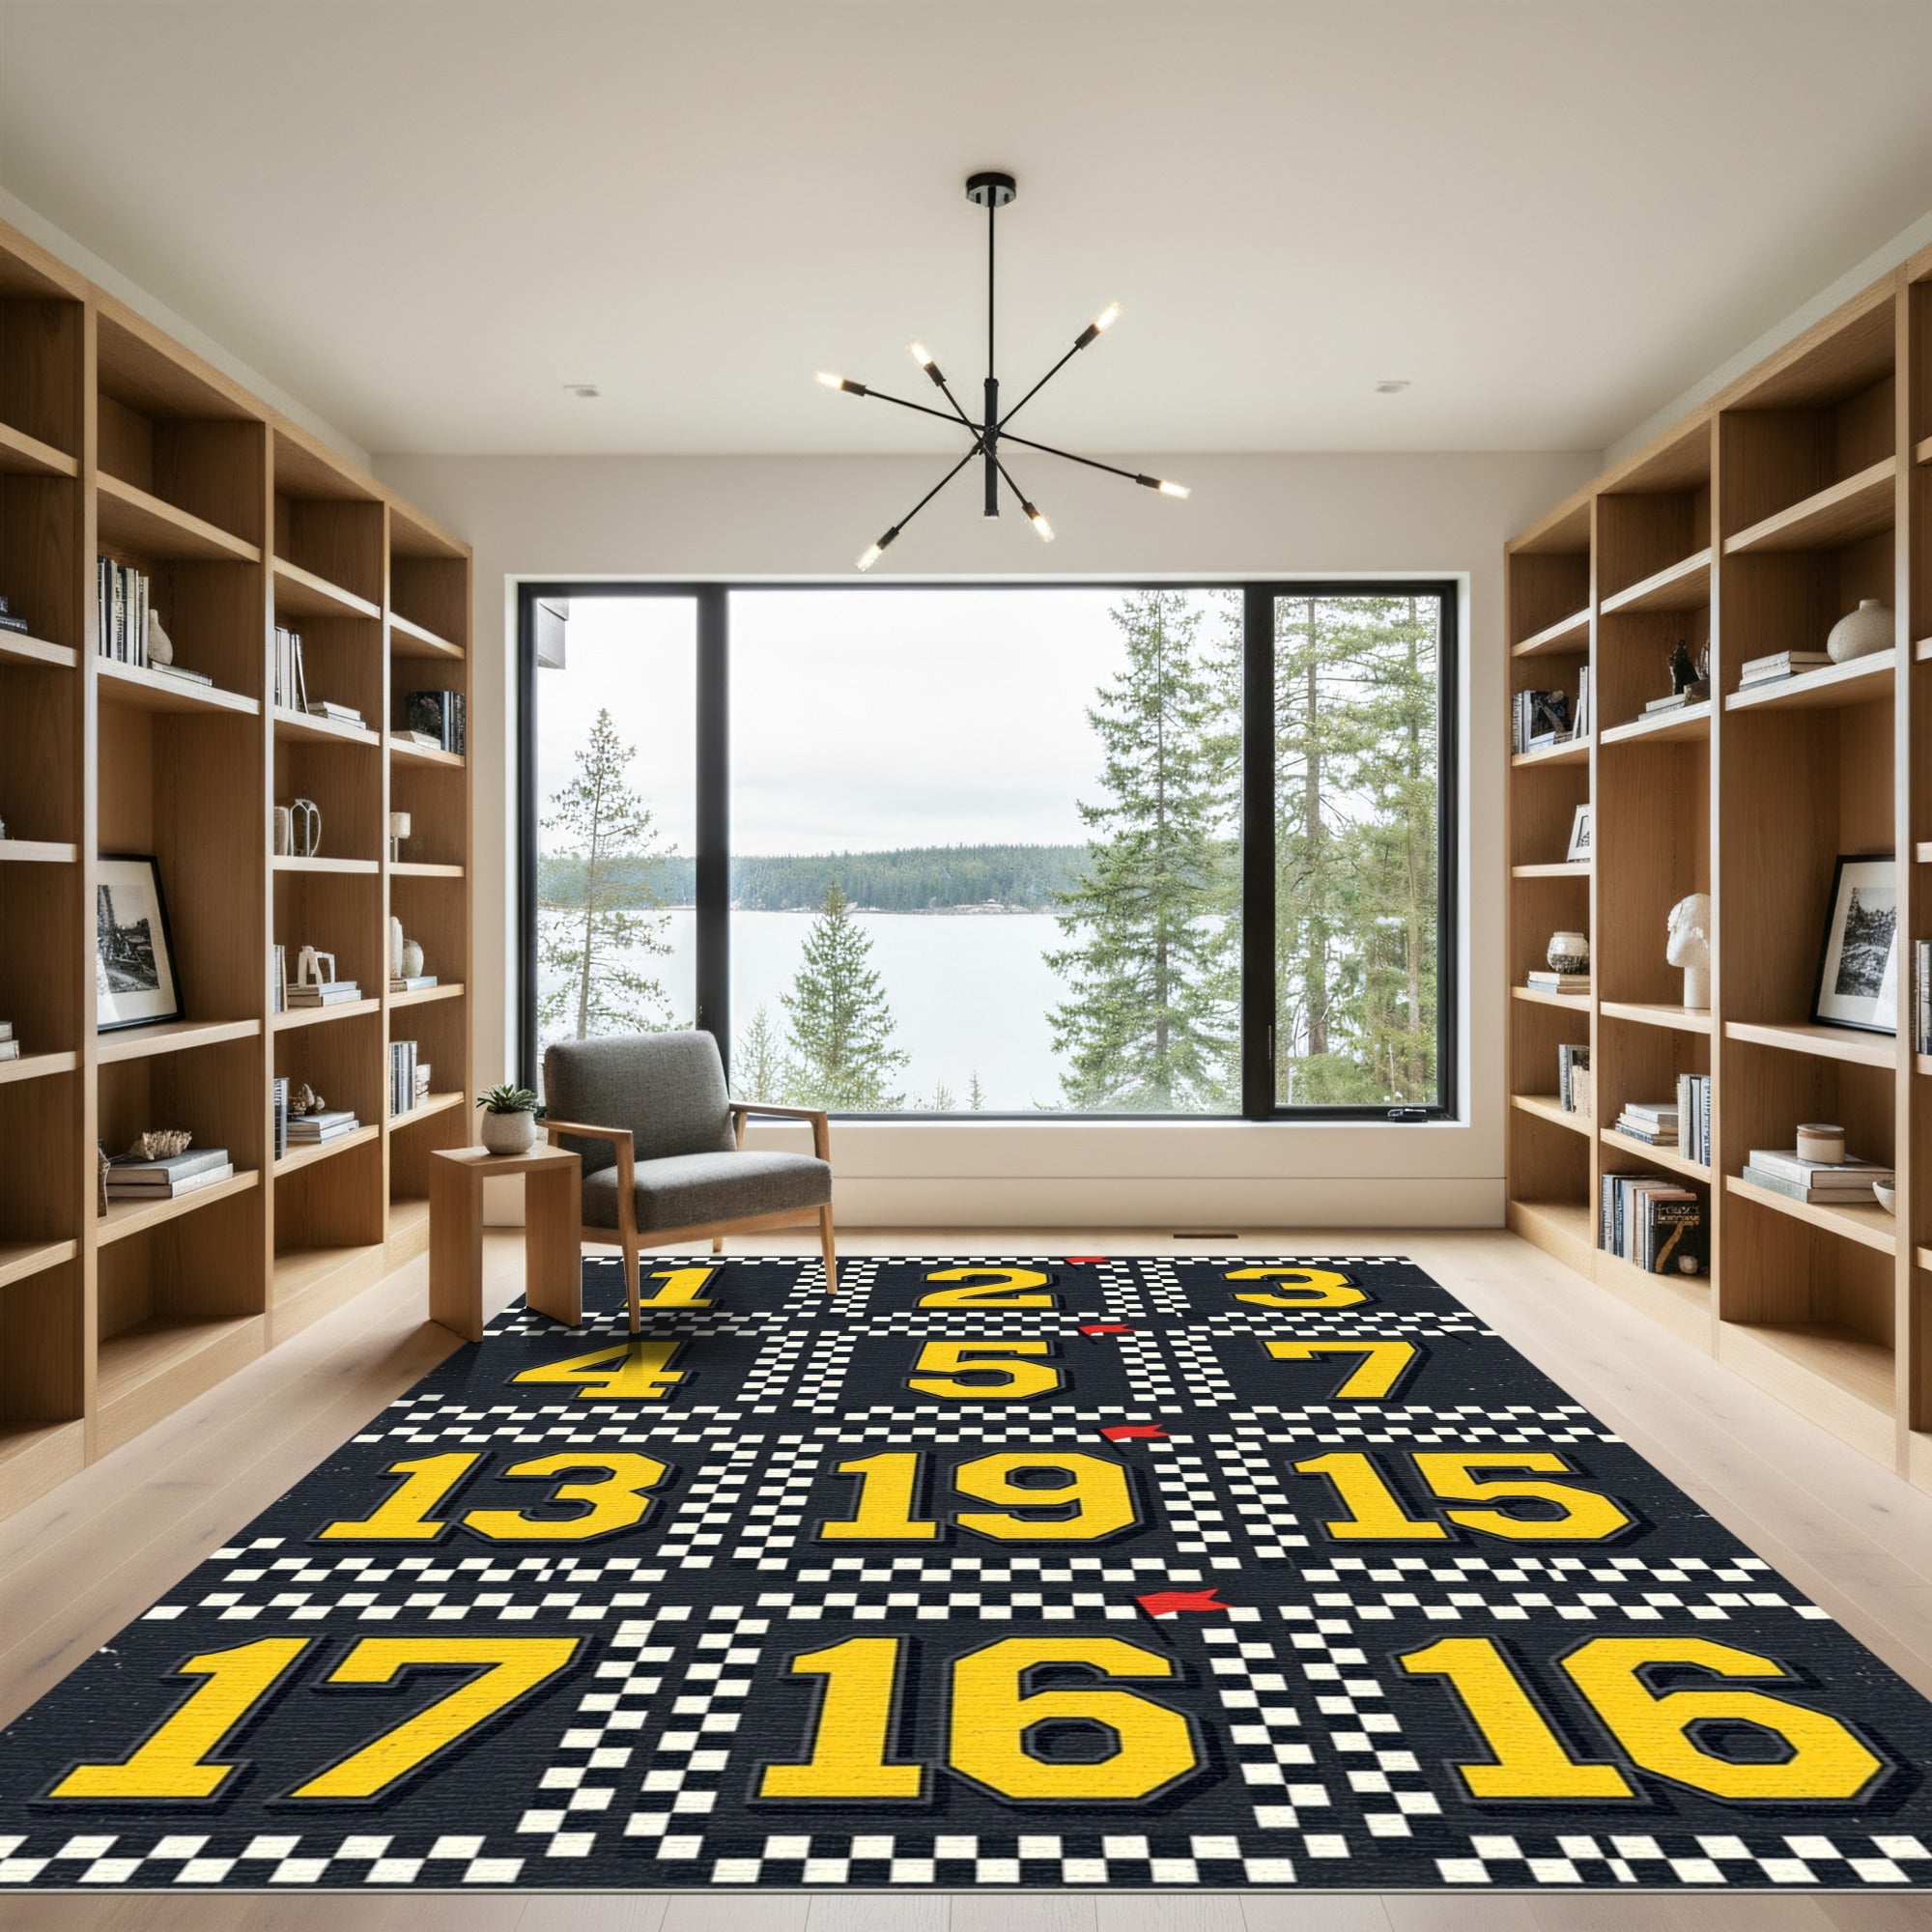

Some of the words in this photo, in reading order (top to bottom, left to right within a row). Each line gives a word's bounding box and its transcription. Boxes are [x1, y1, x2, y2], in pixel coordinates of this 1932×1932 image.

[621, 1267, 715, 1308] 1
[917, 1267, 1054, 1308] 2
[1224, 1267, 1366, 1308] 3
[511, 1340, 685, 1399] 4
[907, 1341, 1060, 1399] 5
[1264, 1341, 1414, 1399] 7
[318, 1451, 666, 1541] 13
[820, 1451, 1136, 1541] 19
[1293, 1451, 1630, 1541] 15
[50, 1636, 581, 1799] 17
[760, 1636, 1198, 1800] 16
[1398, 1636, 1883, 1801] 16
